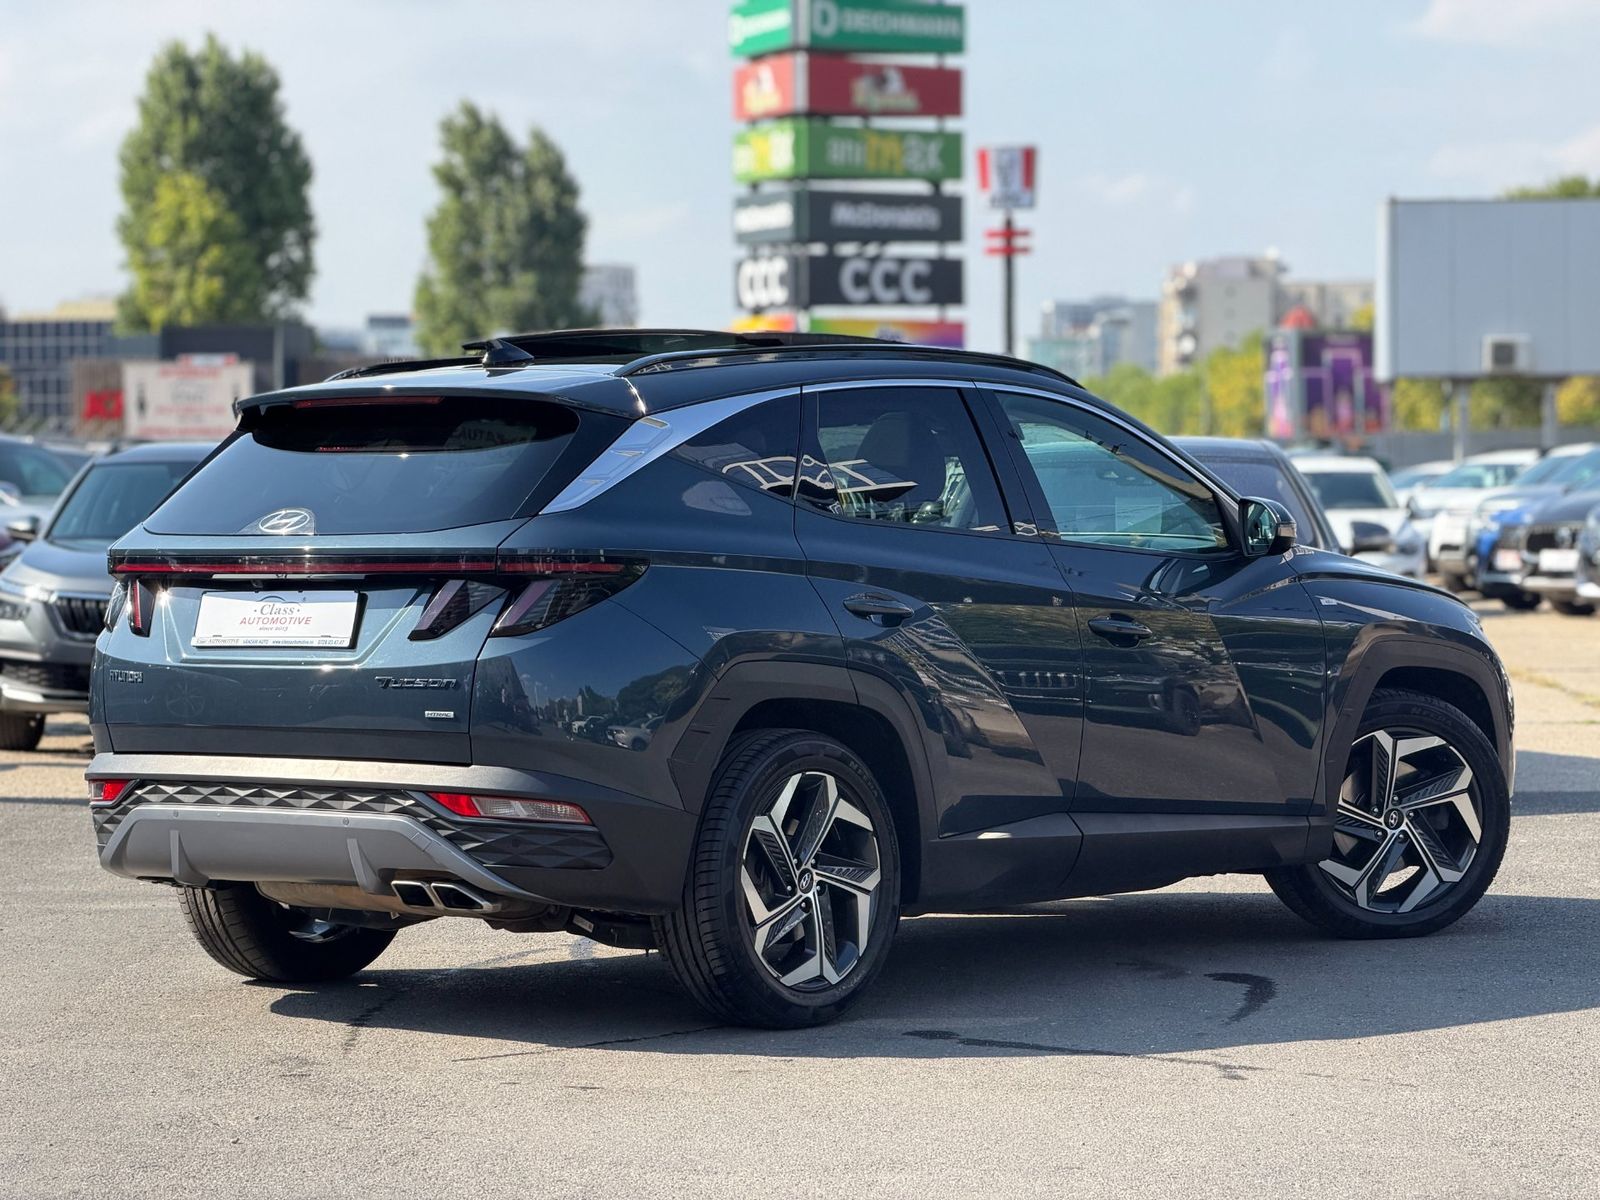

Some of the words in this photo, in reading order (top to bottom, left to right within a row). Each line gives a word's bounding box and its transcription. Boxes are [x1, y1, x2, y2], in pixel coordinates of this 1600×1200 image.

[839, 258, 932, 303] CCC
[260, 603, 295, 615] Class
[240, 616, 312, 625] AUTOMOTIVE
